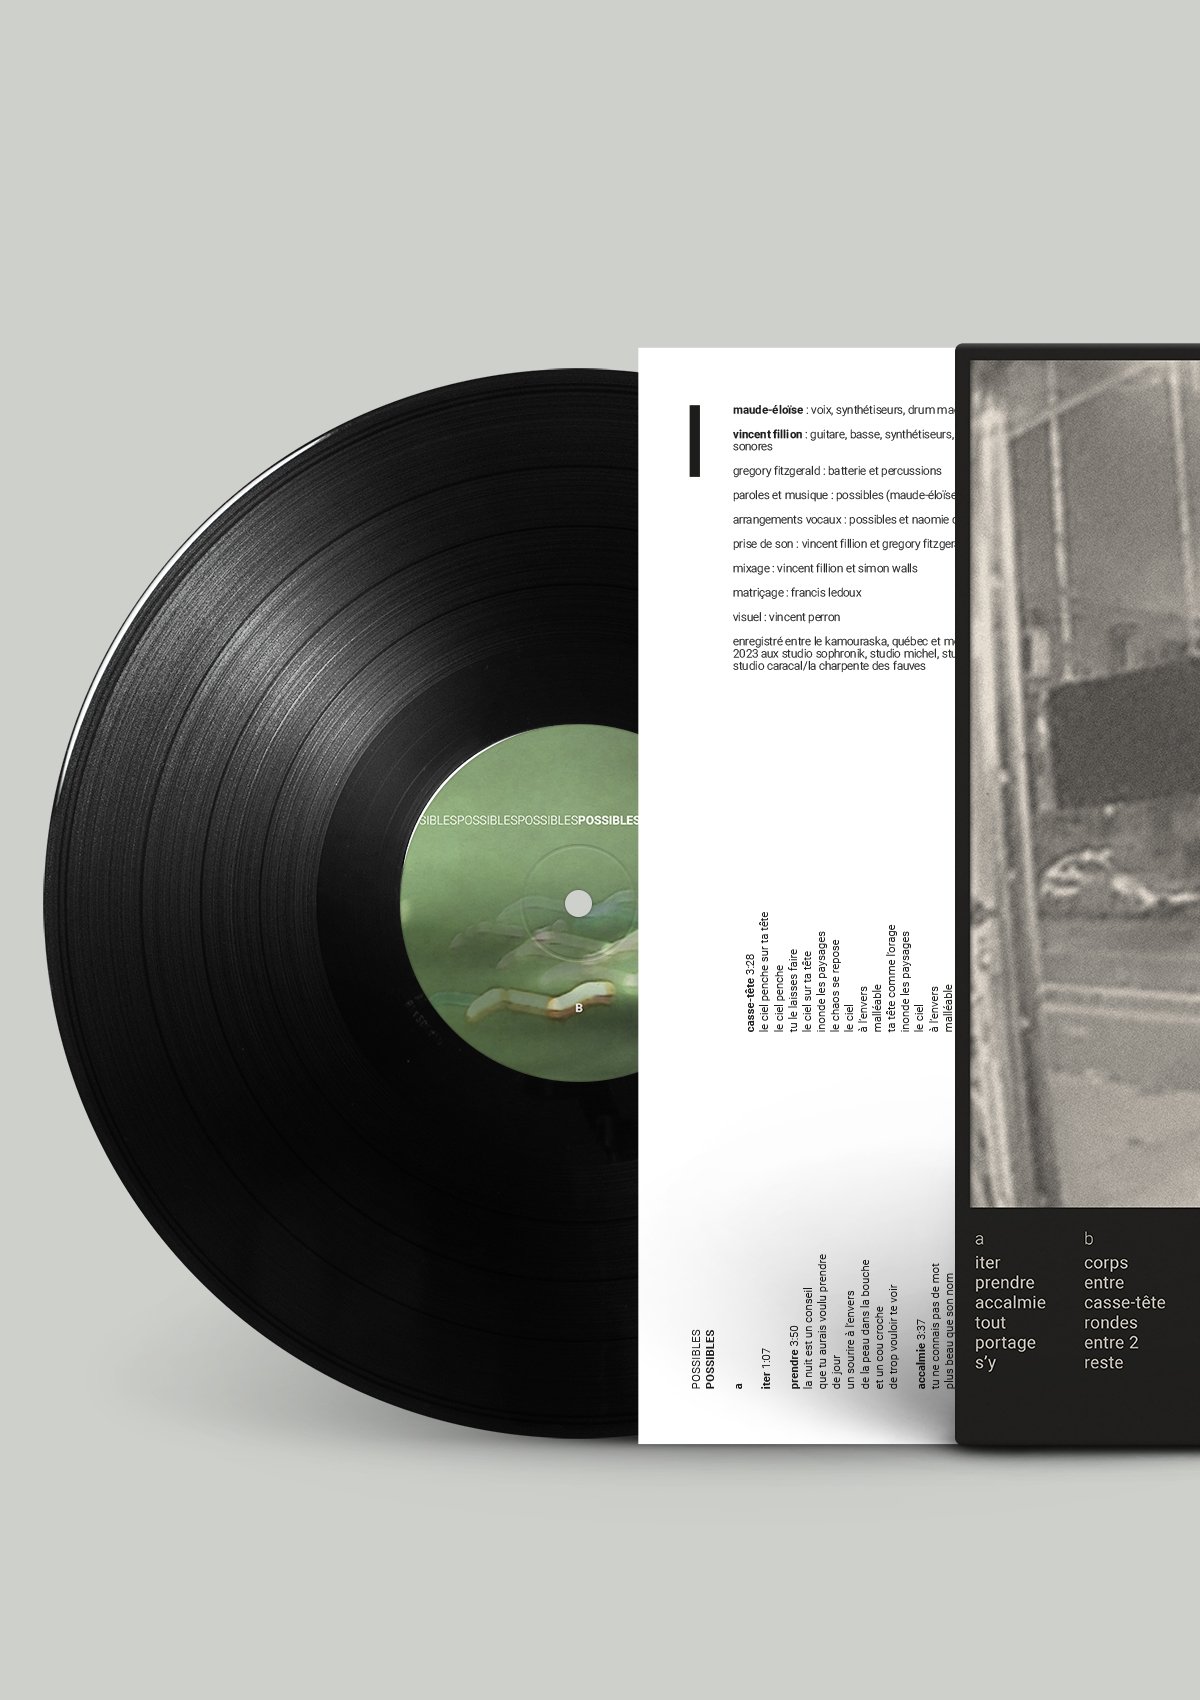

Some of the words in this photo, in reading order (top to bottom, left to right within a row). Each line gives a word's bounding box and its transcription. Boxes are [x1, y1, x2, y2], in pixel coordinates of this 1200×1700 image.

[733, 405, 803, 414] maude-éloïse
[811, 405, 833, 416] voix,
[836, 405, 905, 416] synthétiseurs,
[908, 405, 935, 415] drum
[733, 429, 771, 439] vincent
[773, 429, 802, 439] fillion
[810, 429, 847, 441] guitare,
[850, 429, 882, 440] basse,
[885, 429, 954, 441] synthétiseurs,
[733, 443, 773, 451] sonores
[733, 468, 772, 478] gregory
[774, 465, 820, 478] fitzgerald
[828, 466, 866, 475] batterie
[869, 466, 879, 475] et
[881, 466, 942, 477] percussions
[733, 490, 770, 502] paroles
[772, 491, 782, 500] et
[785, 490, 828, 502] musique
[836, 490, 884, 502] possibles
[733, 515, 803, 526] arrangements
[849, 514, 897, 526] possibles
[899, 515, 909, 524] et
[912, 515, 949, 524] naomie
[733, 539, 757, 550] prise
[760, 539, 772, 548] de
[802, 539, 838, 548] vincent
[840, 538, 867, 548] fillion
[870, 539, 880, 548] et
[882, 540, 921, 551] gregory
[923, 539, 955, 551] fitzger
[733, 563, 770, 575] mixage
[777, 563, 814, 573] vincent
[816, 563, 843, 573] fillion
[846, 564, 856, 573] et
[858, 563, 889, 573] simon
[892, 563, 918, 573] walls
[733, 588, 784, 599] matriçage
[791, 587, 826, 597] francis
[828, 587, 862, 597] ledoux
[733, 612, 761, 622] visuel
[769, 612, 806, 622] vincent
[808, 614, 840, 624] perron
[733, 636, 783, 648] enregistré
[785, 637, 811, 646] entre
[814, 636, 822, 646] le
[825, 636, 889, 647] kamouraska,
[891, 636, 928, 649] québec
[931, 637, 941, 646] et
[733, 649, 758, 658] 2023
[782, 648, 813, 658] studio
[816, 648, 867, 660] sophronik,
[870, 647, 901, 658] studio
[904, 648, 939, 660] michel,
[733, 661, 765, 670] studio
[767, 661, 816, 671] caracal/la
[819, 661, 869, 672] charpente
[872, 661, 890, 670] des
[893, 660, 926, 670] fauves
[759, 912, 768, 931] tête
[761, 934, 768, 944] ta
[788, 949, 797, 971] faire
[818, 931, 827, 978] paysages
[832, 939, 841, 973] repose
[746, 954, 754, 975] 3:28
[760, 965, 770, 1001] penche
[816, 982, 825, 995] les
[832, 976, 839, 988] se
[788, 974, 797, 1008] laisses
[575, 1003, 584, 1013] B
[745, 978, 754, 1032] casse-tête
[831, 991, 839, 1021] chaos
[872, 984, 881, 1032] malléable
[886, 1001, 895, 1020] tête
[759, 1005, 768, 1021] ciel
[788, 1011, 797, 1019] le
[817, 998, 825, 1032] inonde
[759, 1024, 768, 1032] le
[790, 1023, 797, 1033] tu
[830, 1024, 839, 1032] le
[888, 1023, 895, 1033] ta
[976, 1235, 983, 1245] a
[1085, 1232, 1093, 1245] b
[976, 1256, 1000, 1269] iter
[1085, 1259, 1128, 1272] corps
[817, 1254, 828, 1292] prendre
[931, 1262, 939, 1283] mot
[976, 1275, 1034, 1292] prendre
[1085, 1277, 1124, 1289] entre
[889, 1284, 897, 1303] voir
[931, 1286, 939, 1298] de
[803, 1288, 812, 1323] conseil
[817, 1295, 826, 1322] voulu
[976, 1295, 1045, 1309] accalmie
[1085, 1295, 1165, 1309] casse-tête
[890, 1306, 897, 1315] te
[932, 1301, 941, 1319] pas
[875, 1306, 884, 1340] croche
[975, 1317, 1006, 1329] tout
[1085, 1315, 1137, 1329] rondes
[790, 1325, 798, 1346] 3:50
[805, 1326, 812, 1338] un
[888, 1317, 897, 1351] vouloir
[916, 1319, 926, 1340] 3:37
[817, 1325, 827, 1355] aurais
[930, 1322, 940, 1362] connais
[976, 1337, 1035, 1352] portage
[1085, 1337, 1124, 1349] entre
[1130, 1336, 1138, 1349] 2
[692, 1329, 700, 1389] POSSIBLES
[706, 1330, 715, 1389] POSSIBLES
[762, 1348, 770, 1369] 1:07
[846, 1339, 854, 1374] sourire
[875, 1343, 884, 1362] cou
[790, 1349, 800, 1389] prendre
[804, 1359, 812, 1377] nuit
[819, 1358, 826, 1368] tu
[832, 1355, 842, 1375] jour
[890, 1354, 899, 1374] trop
[916, 1343, 926, 1389] accalmie
[932, 1364, 940, 1376] ne
[976, 1355, 996, 1372] s’y
[1085, 1357, 1123, 1369] reste
[875, 1365, 883, 1377] un
[761, 1371, 770, 1389] iter
[803, 1381, 812, 1389] la
[819, 1371, 828, 1389] que
[832, 1377, 840, 1389] de
[847, 1377, 854, 1389] un
[876, 1380, 884, 1389] et
[888, 1377, 897, 1389] de
[931, 1380, 939, 1390] tu
